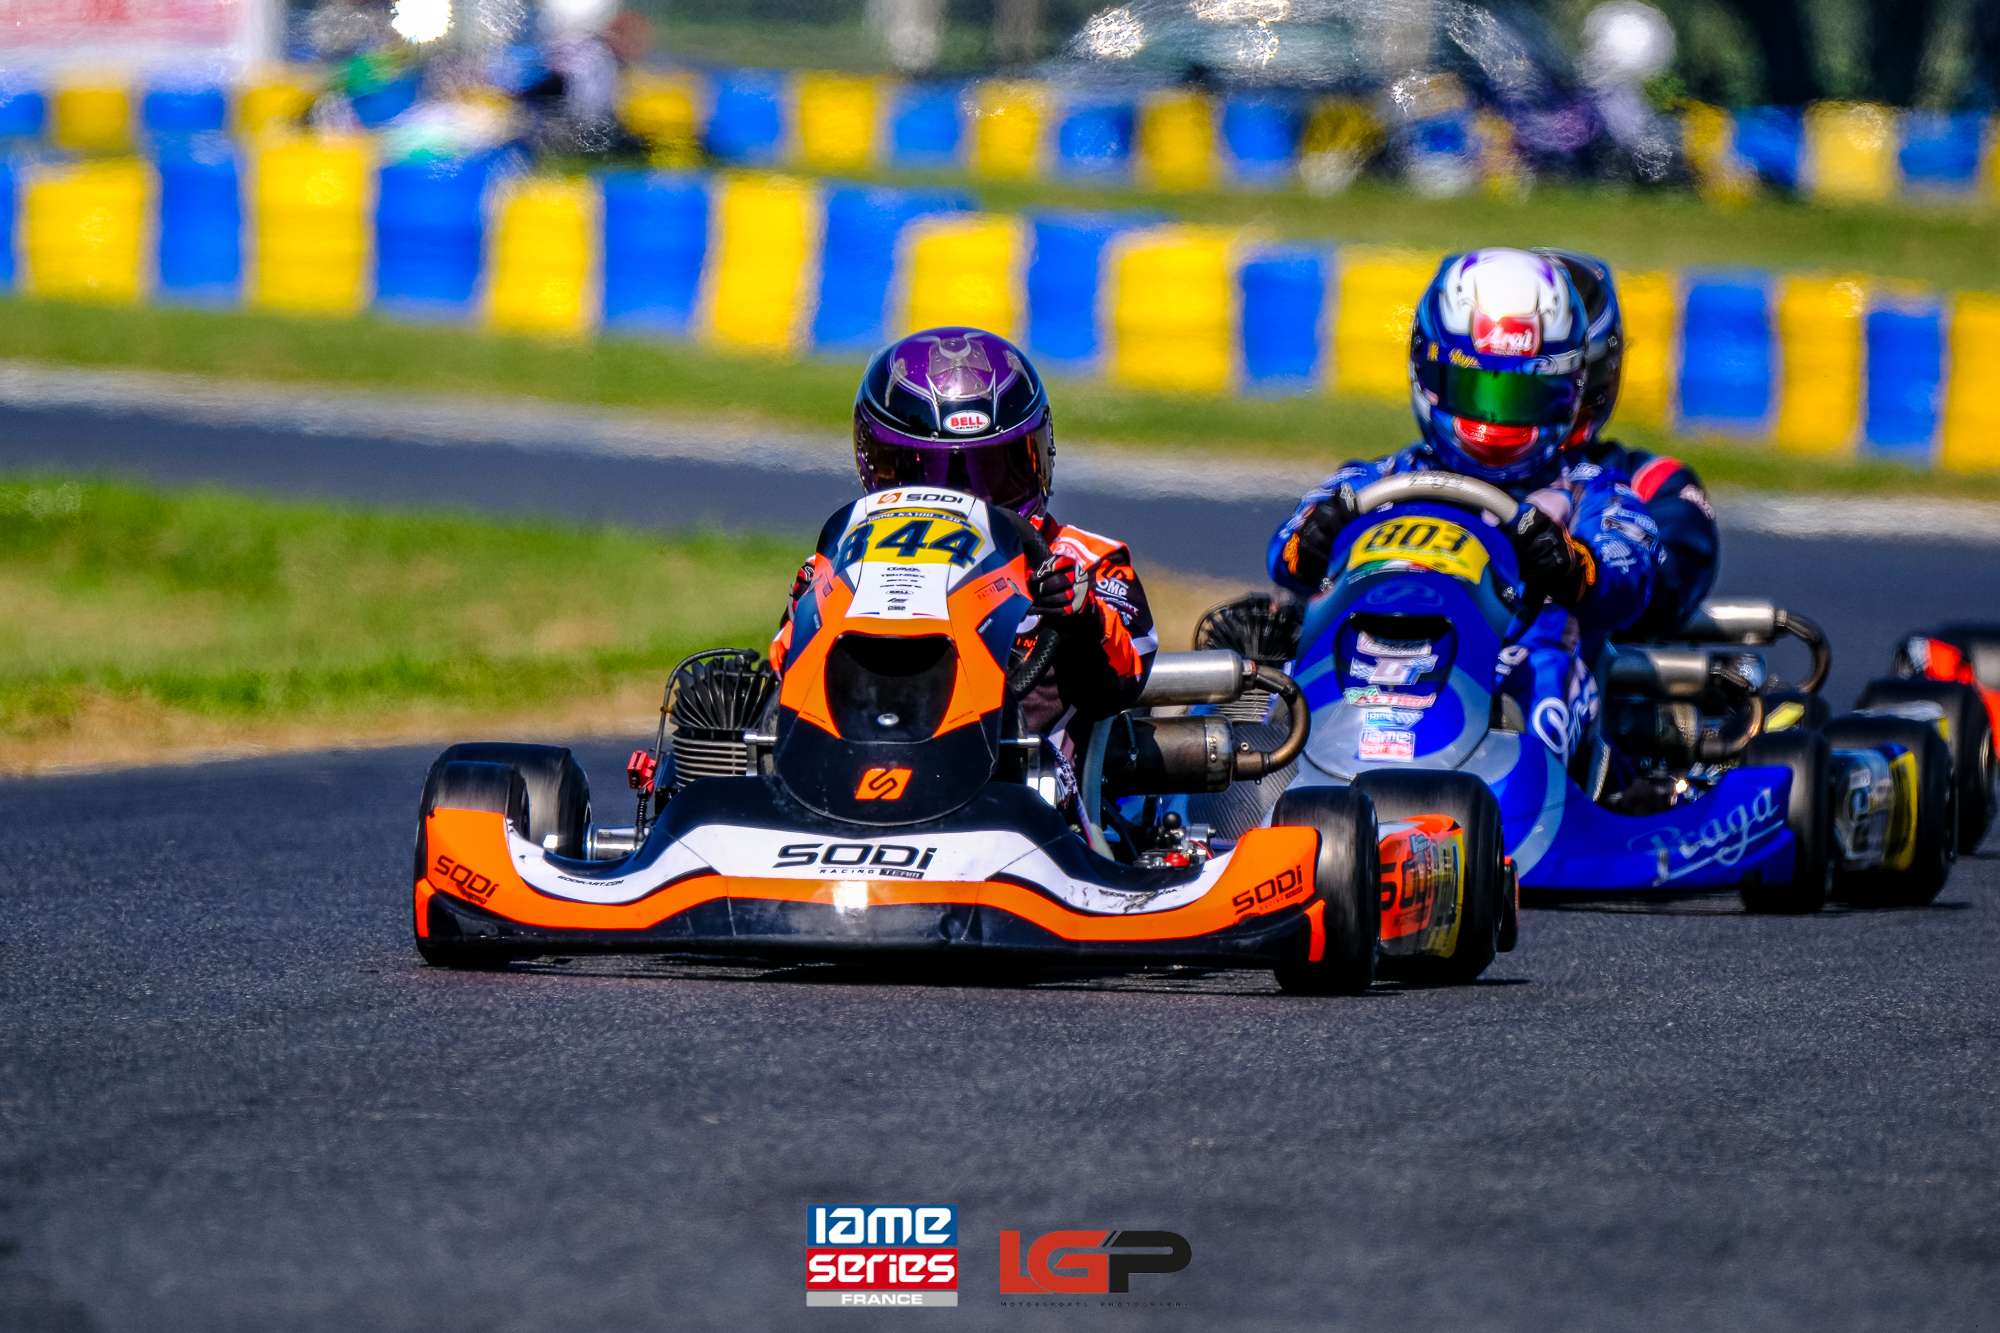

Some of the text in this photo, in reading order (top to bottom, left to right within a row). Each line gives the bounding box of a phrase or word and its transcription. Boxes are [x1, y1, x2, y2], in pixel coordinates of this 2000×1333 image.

[951, 416, 983, 427] BELL
[905, 493, 963, 504] SODI
[833, 520, 981, 575] 844
[1364, 523, 1469, 553] 803
